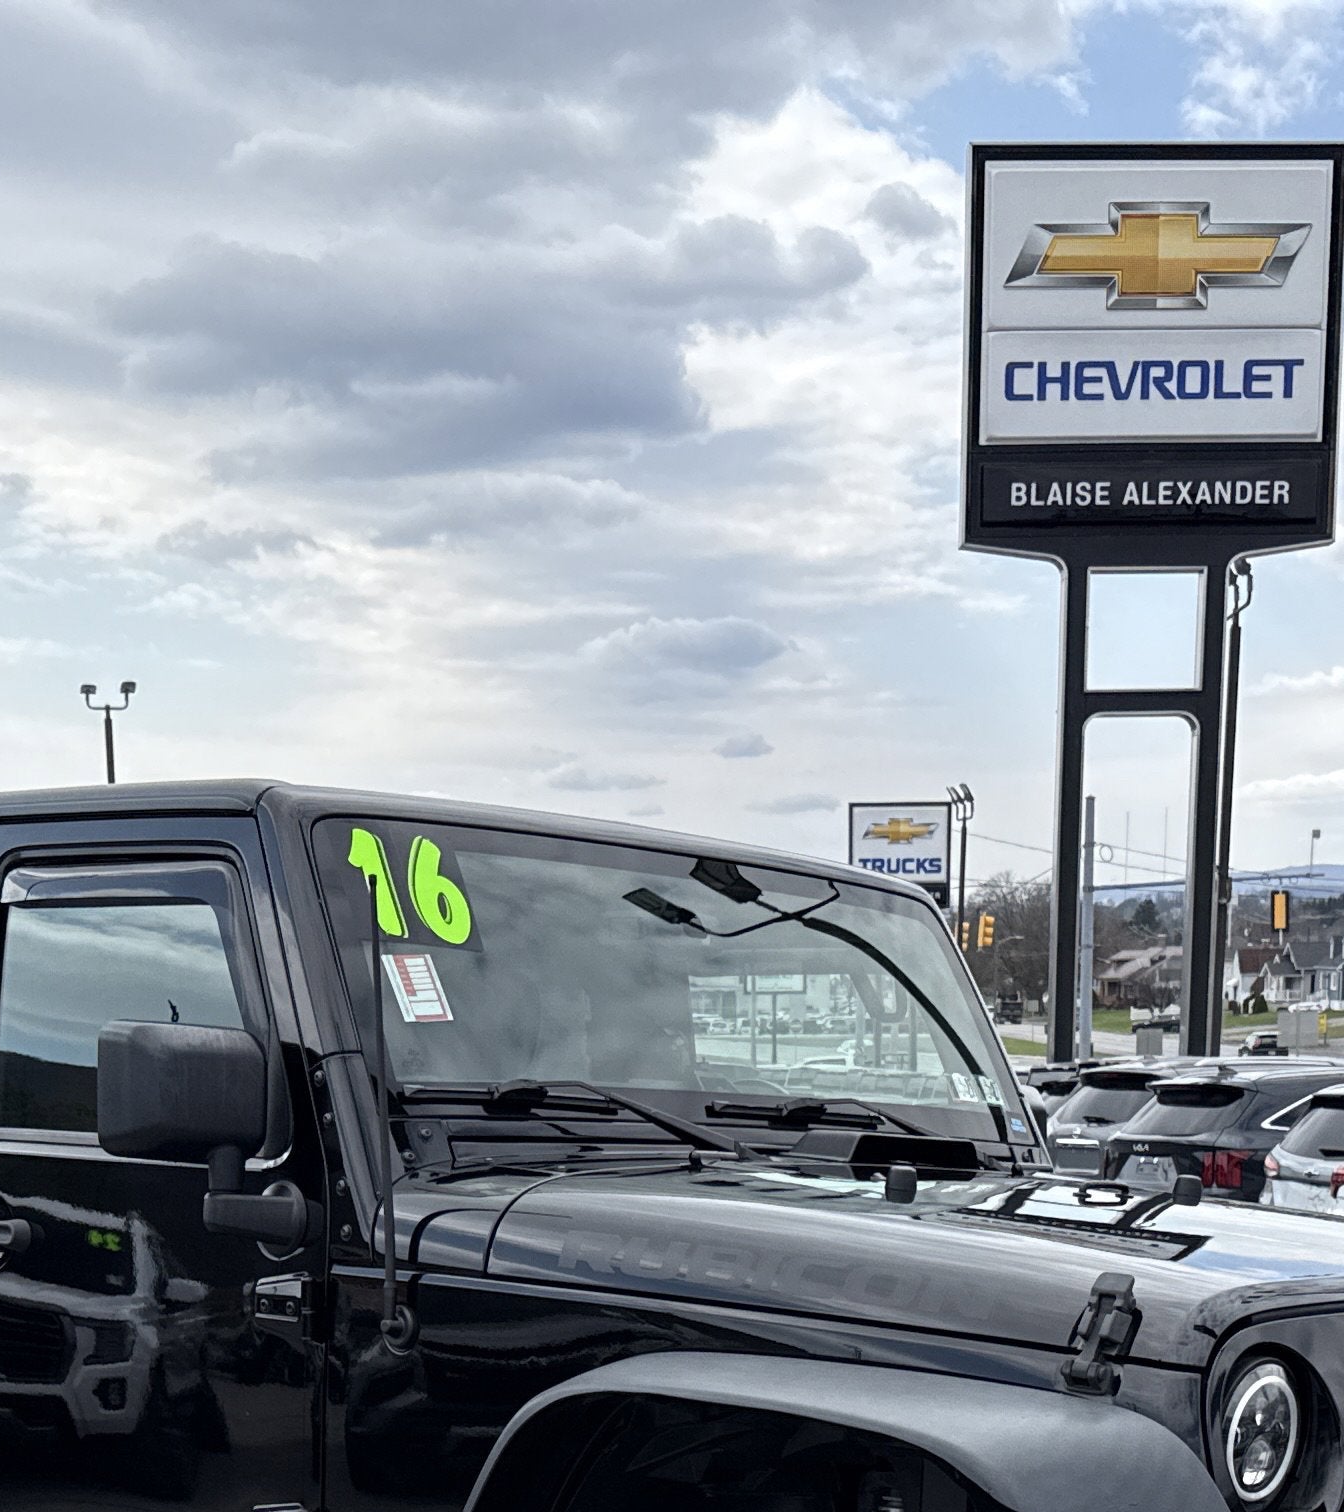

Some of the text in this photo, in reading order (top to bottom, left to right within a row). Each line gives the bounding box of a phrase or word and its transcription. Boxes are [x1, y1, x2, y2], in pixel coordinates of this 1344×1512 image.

[1005, 358, 1304, 401] CHEVROLET
[1010, 481, 1290, 506] BLAISE ALEXANDER
[859, 858, 942, 874] TRUCKS
[348, 828, 471, 945] 16
